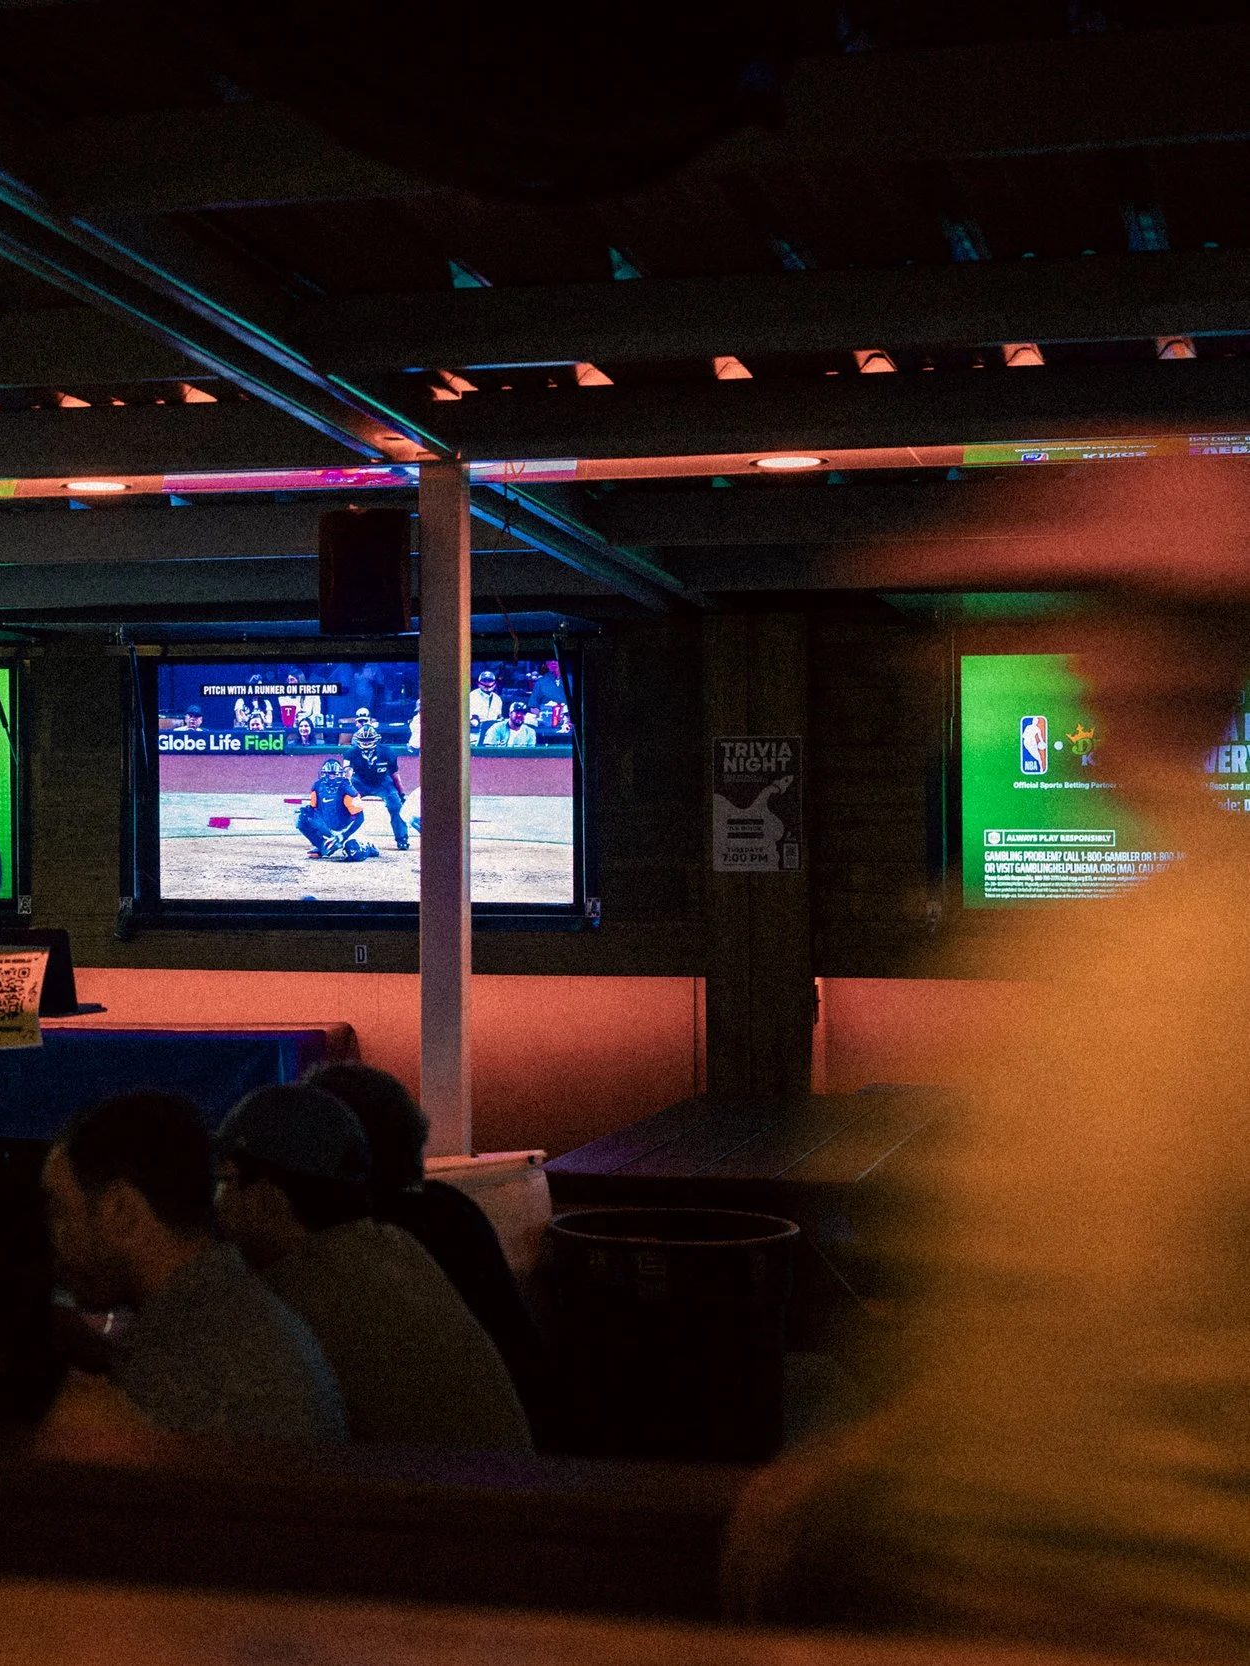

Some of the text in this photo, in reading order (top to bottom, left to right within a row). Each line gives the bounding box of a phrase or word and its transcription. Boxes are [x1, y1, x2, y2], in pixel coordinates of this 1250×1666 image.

[203, 684, 338, 695] PITCH WITH A RUNNER ON FIRST AND
[158, 734, 284, 751] Globe Life Field
[721, 742, 792, 757] TRIVIA
[723, 758, 790, 772] NIGHT
[1024, 761, 1038, 771] NBA
[1013, 781, 1039, 789] Official
[1039, 781, 1063, 790] Sports
[1064, 781, 1090, 790] Betting
[1230, 782, 1244, 790] and
[985, 851, 1023, 861] GAMBLING
[1024, 851, 1062, 861] PROBLEM?
[1063, 851, 1080, 861] CALL
[1081, 851, 1140, 861] 1-800-GAMBLER
[1141, 852, 1152, 861] OR
[985, 863, 995, 873] OR
[996, 863, 1014, 873] VISIT
[1015, 863, 1116, 874] GAMBLINGHELPLINEMA.ORG
